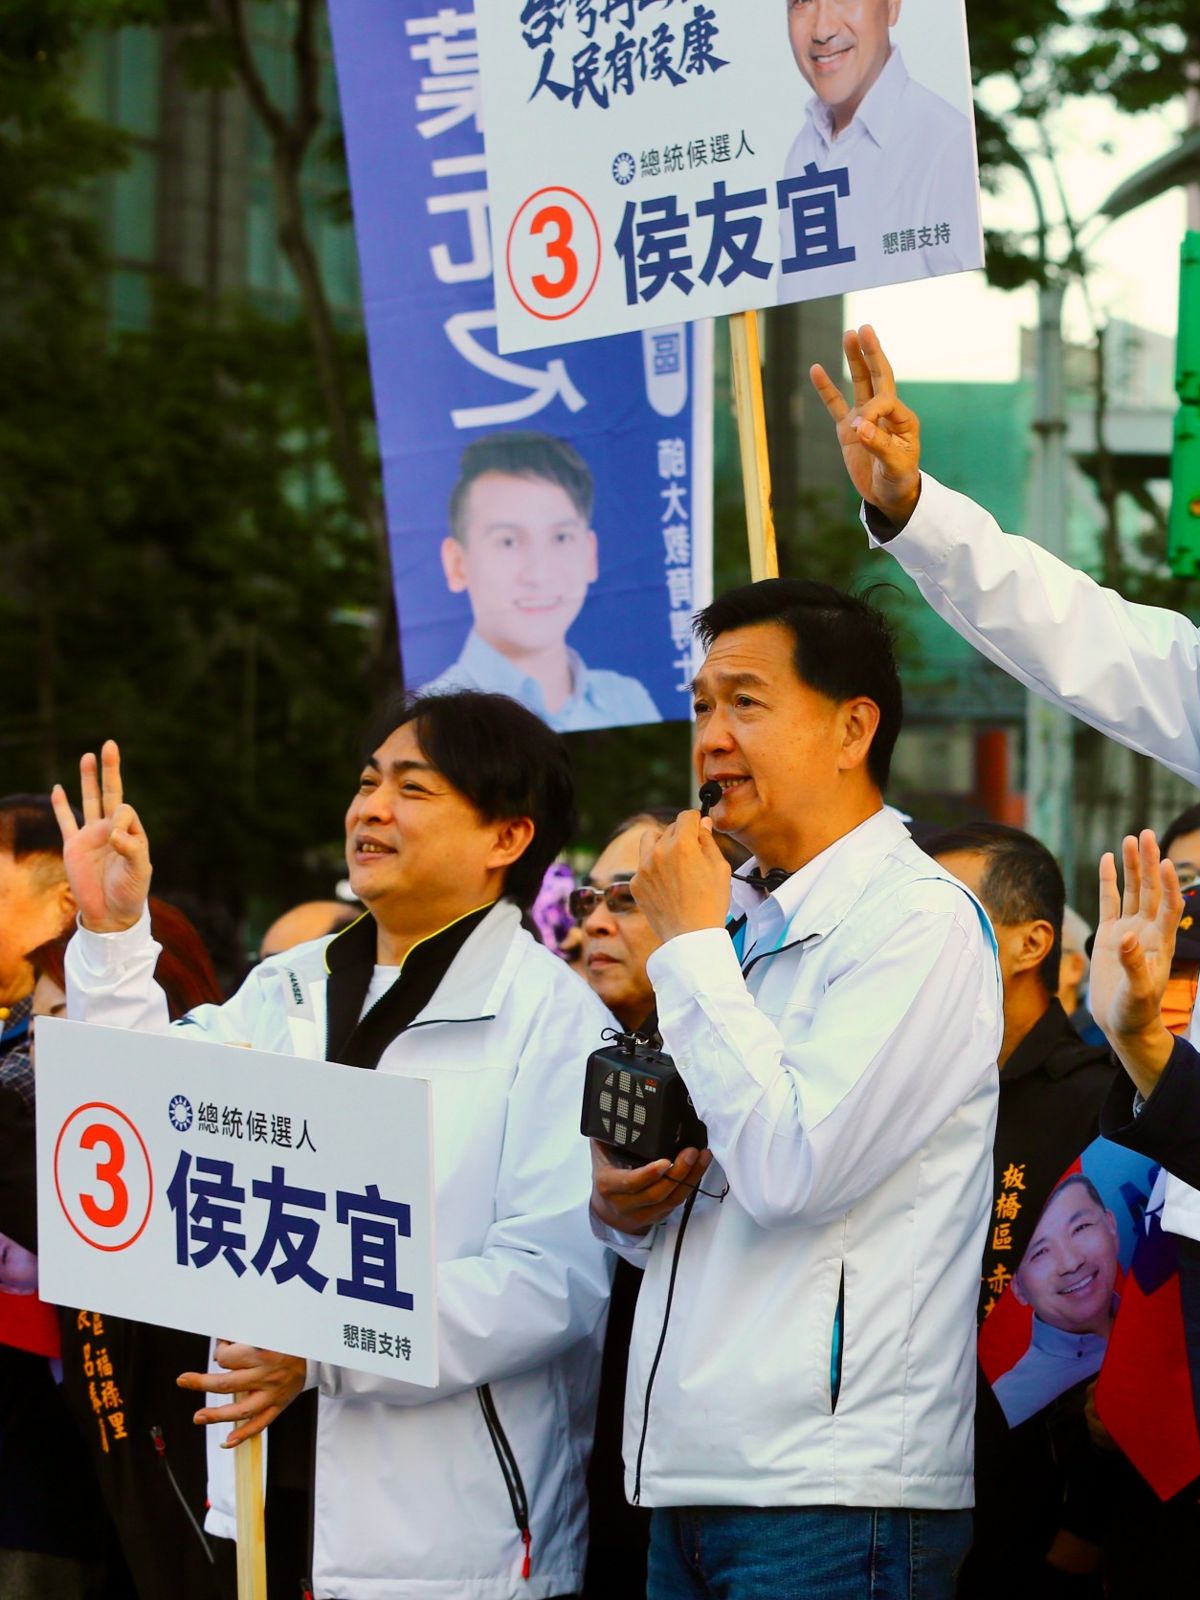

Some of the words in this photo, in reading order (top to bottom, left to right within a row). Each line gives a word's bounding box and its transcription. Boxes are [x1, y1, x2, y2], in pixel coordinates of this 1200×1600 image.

[639, 130, 755, 178] 總統候選人
[529, 205, 579, 300] 3
[614, 162, 857, 306] 侯友宜
[882, 222, 951, 255] 懇請支持
[198, 1101, 317, 1153] 總統候選人
[79, 1123, 129, 1227] 3
[166, 1149, 414, 1311] 侯友宜
[343, 1323, 411, 1361] 懇請支持
